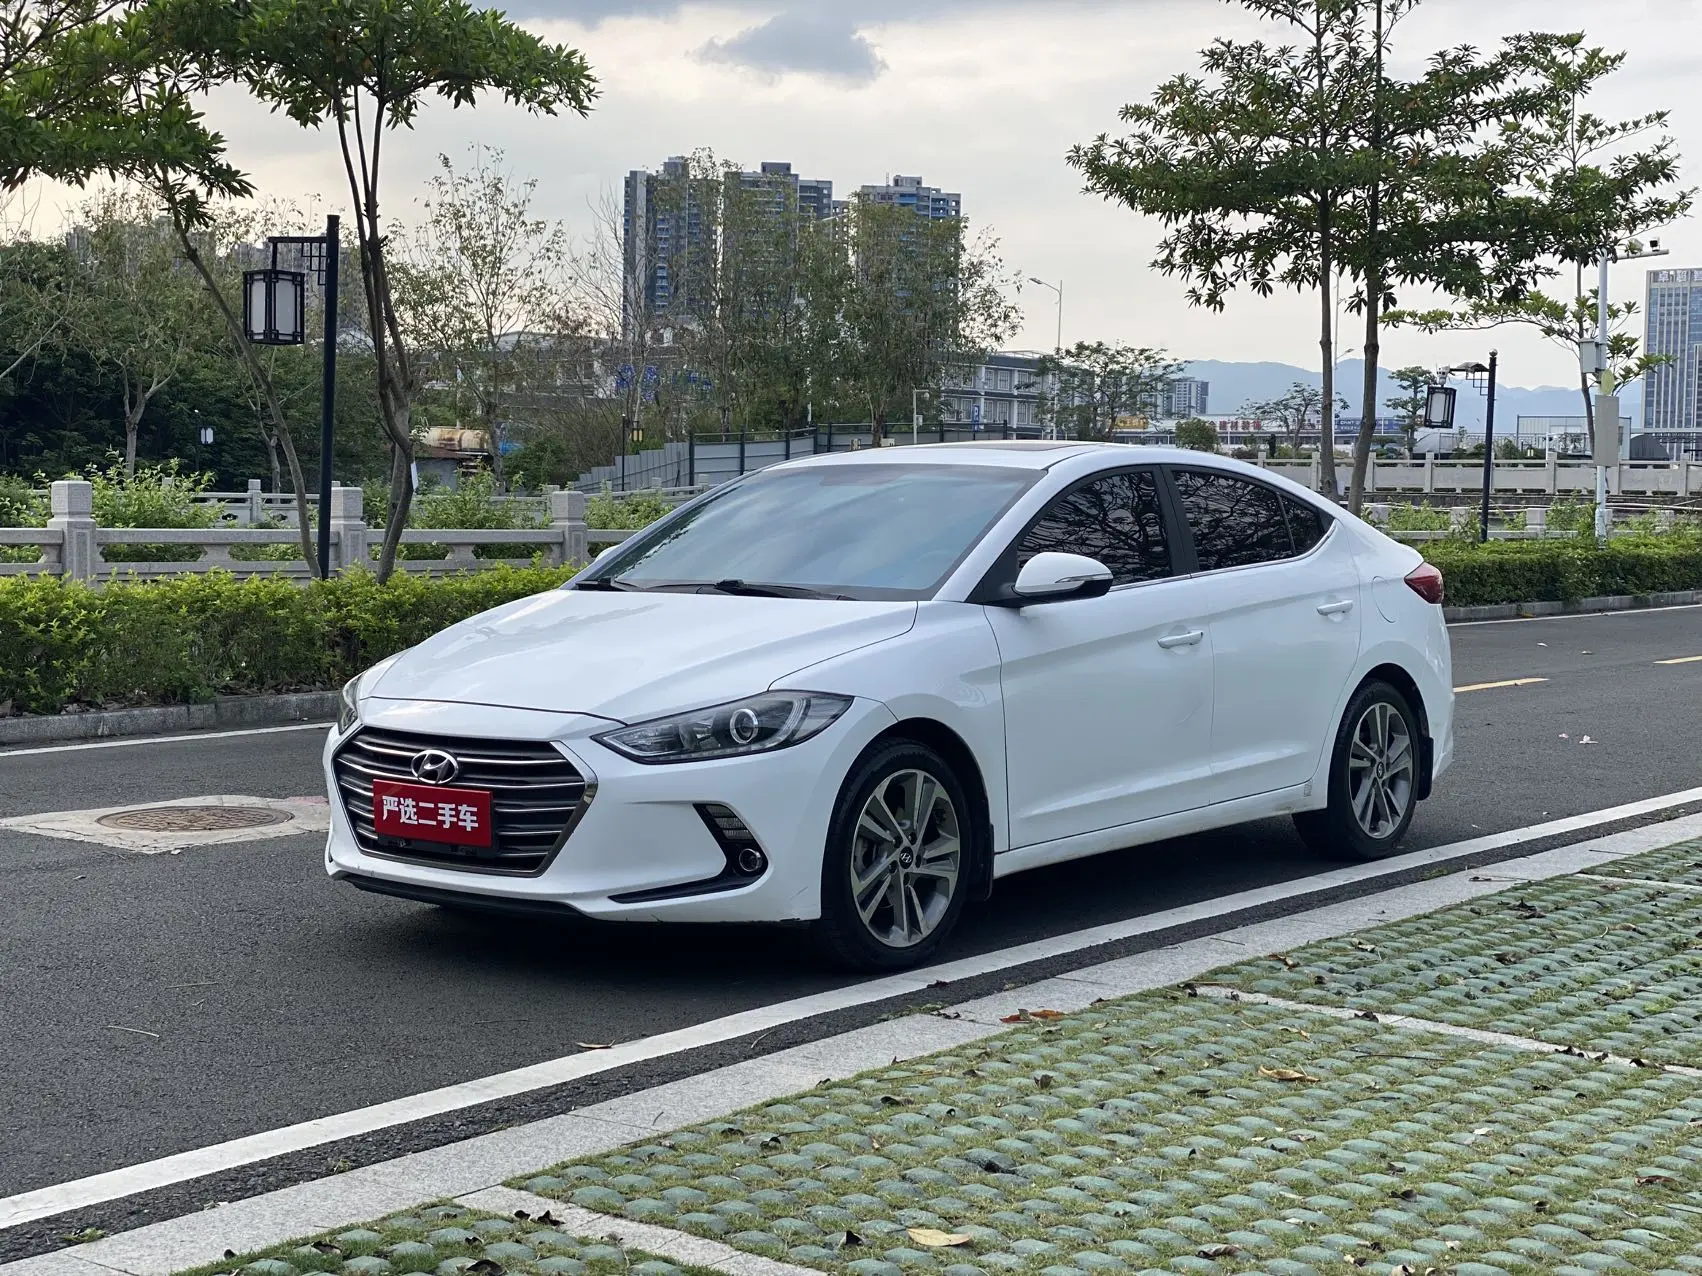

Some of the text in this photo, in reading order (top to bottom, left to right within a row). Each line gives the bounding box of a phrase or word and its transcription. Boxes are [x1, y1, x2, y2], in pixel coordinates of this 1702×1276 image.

[382, 795, 479, 831] 严选二手车
